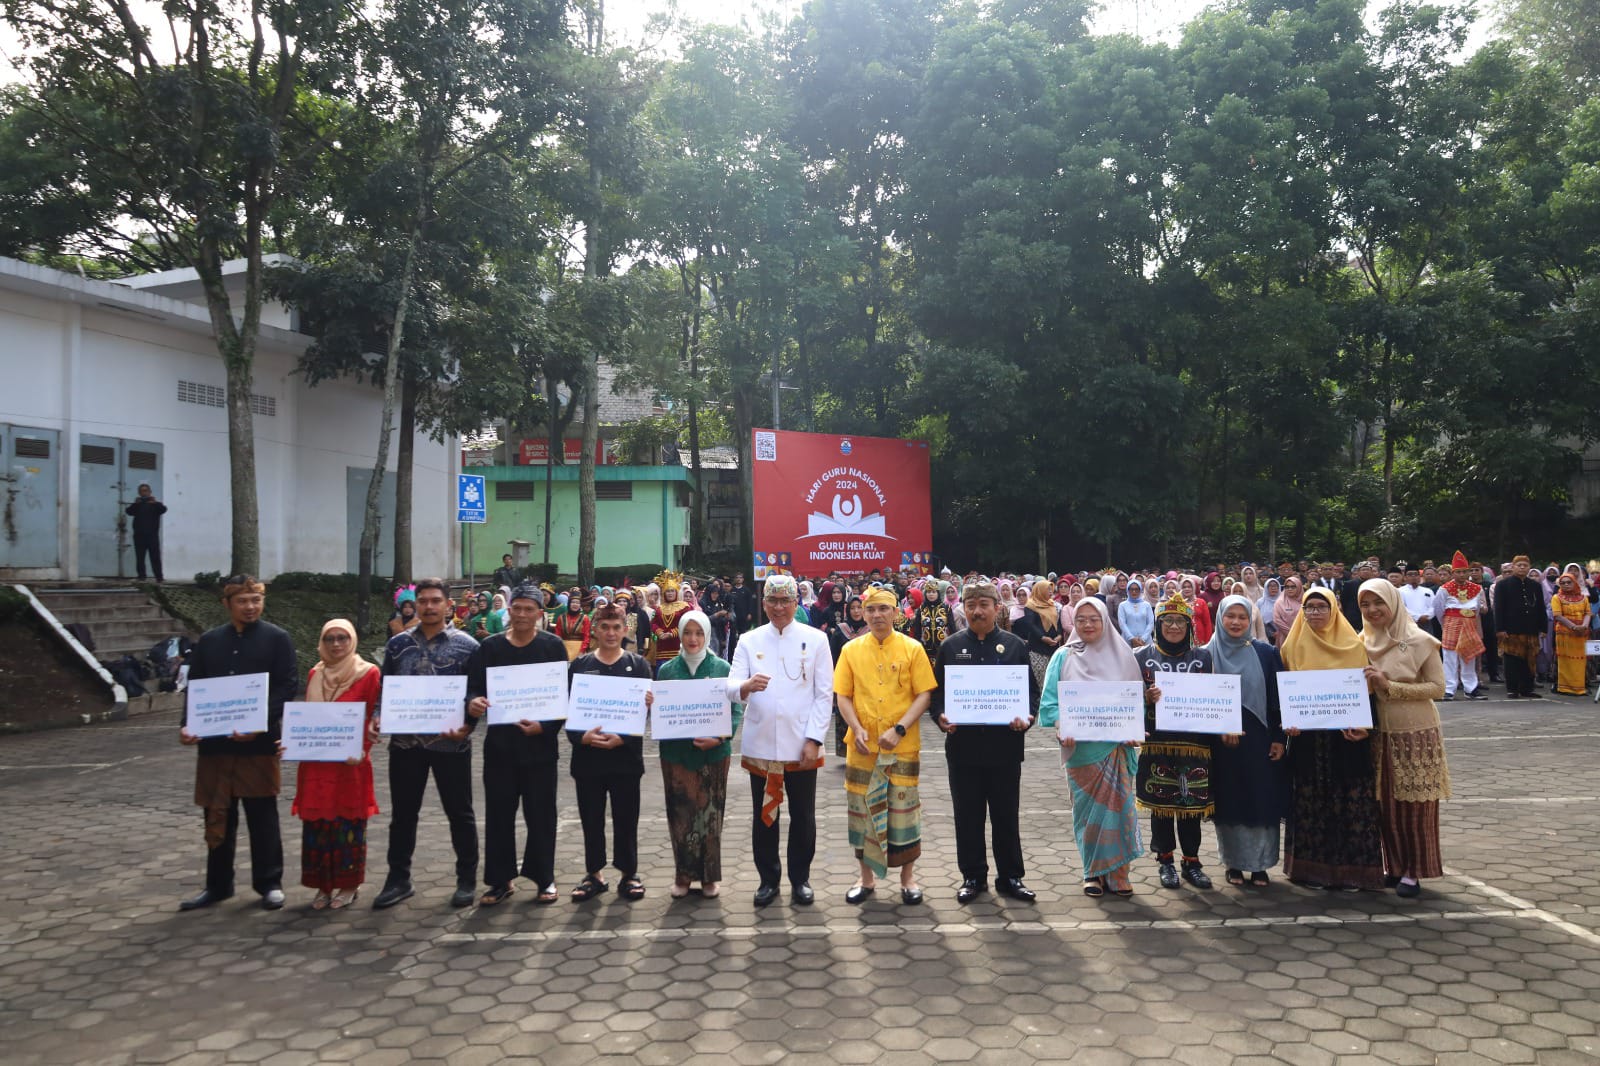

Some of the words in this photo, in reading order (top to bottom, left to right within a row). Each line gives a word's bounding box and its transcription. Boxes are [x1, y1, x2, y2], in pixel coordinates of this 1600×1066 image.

[806, 479, 822, 504] HARI
[822, 467, 846, 481] GURU
[849, 468, 886, 506] NASIONAL
[836, 480, 857, 489] 2024
[819, 542, 844, 550] GURU
[847, 542, 876, 551] HEBAT,
[810, 552, 861, 560] INDONESIA
[600, 699, 640, 707] INSPIRATIF
